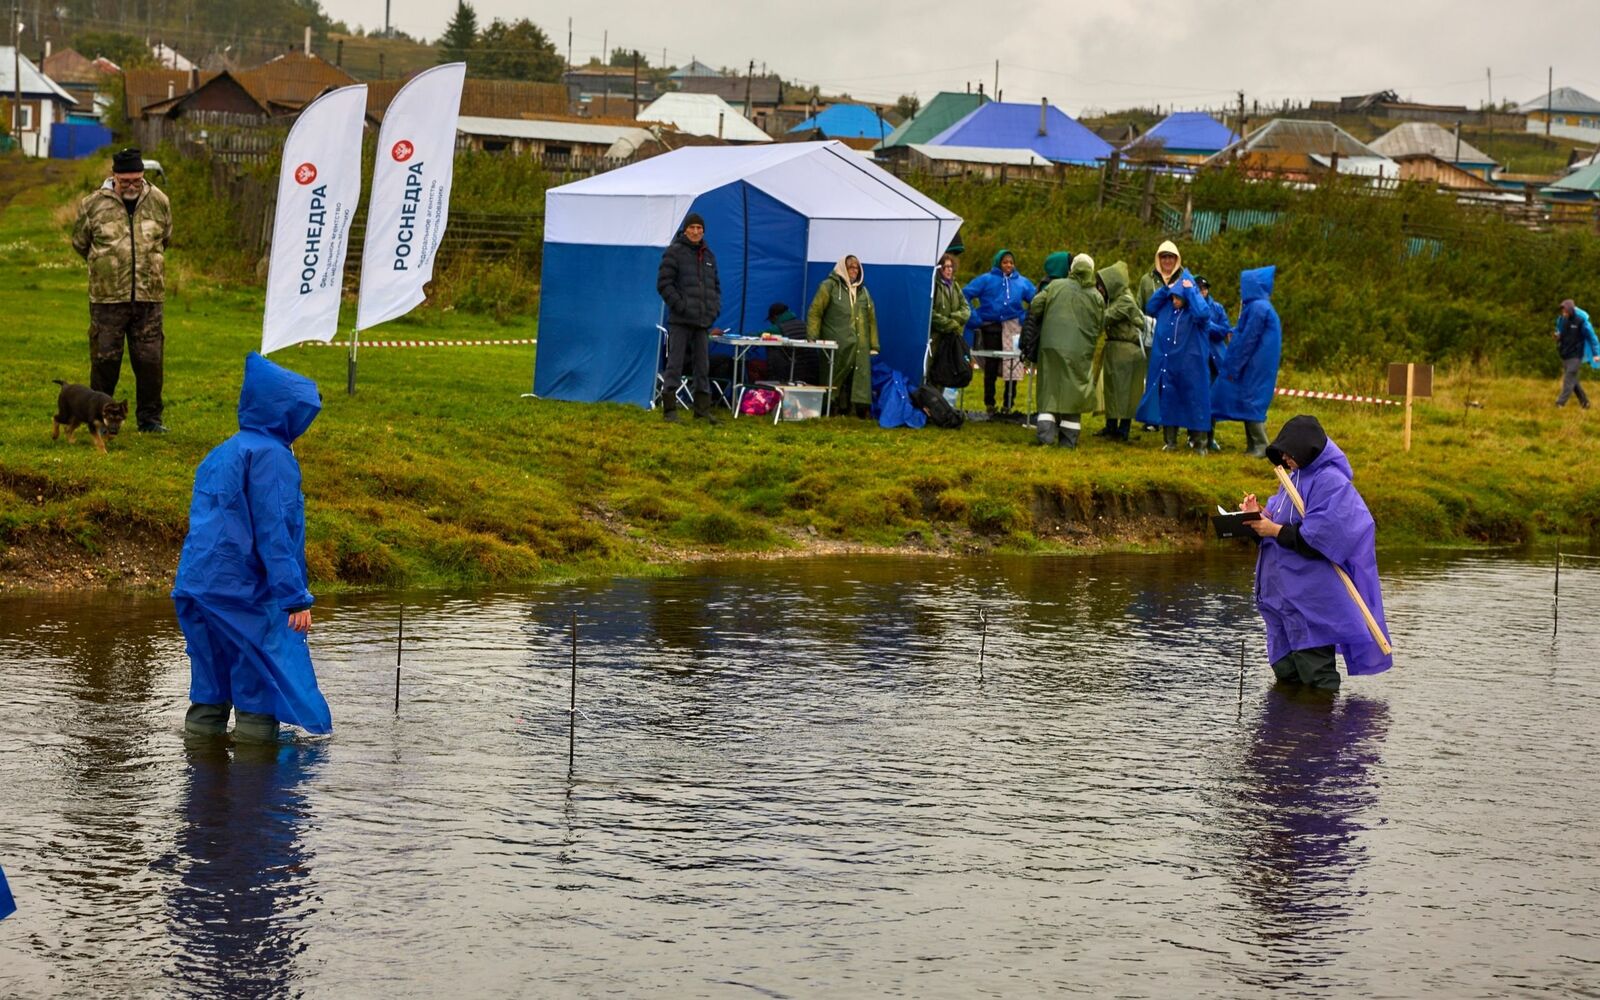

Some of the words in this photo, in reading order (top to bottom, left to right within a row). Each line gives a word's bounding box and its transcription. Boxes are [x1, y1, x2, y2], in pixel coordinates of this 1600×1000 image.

[300, 184, 327, 294] РОСНЕДРА
[394, 161, 424, 270] РОСНЕДРА
[426, 179, 437, 217] агентство
